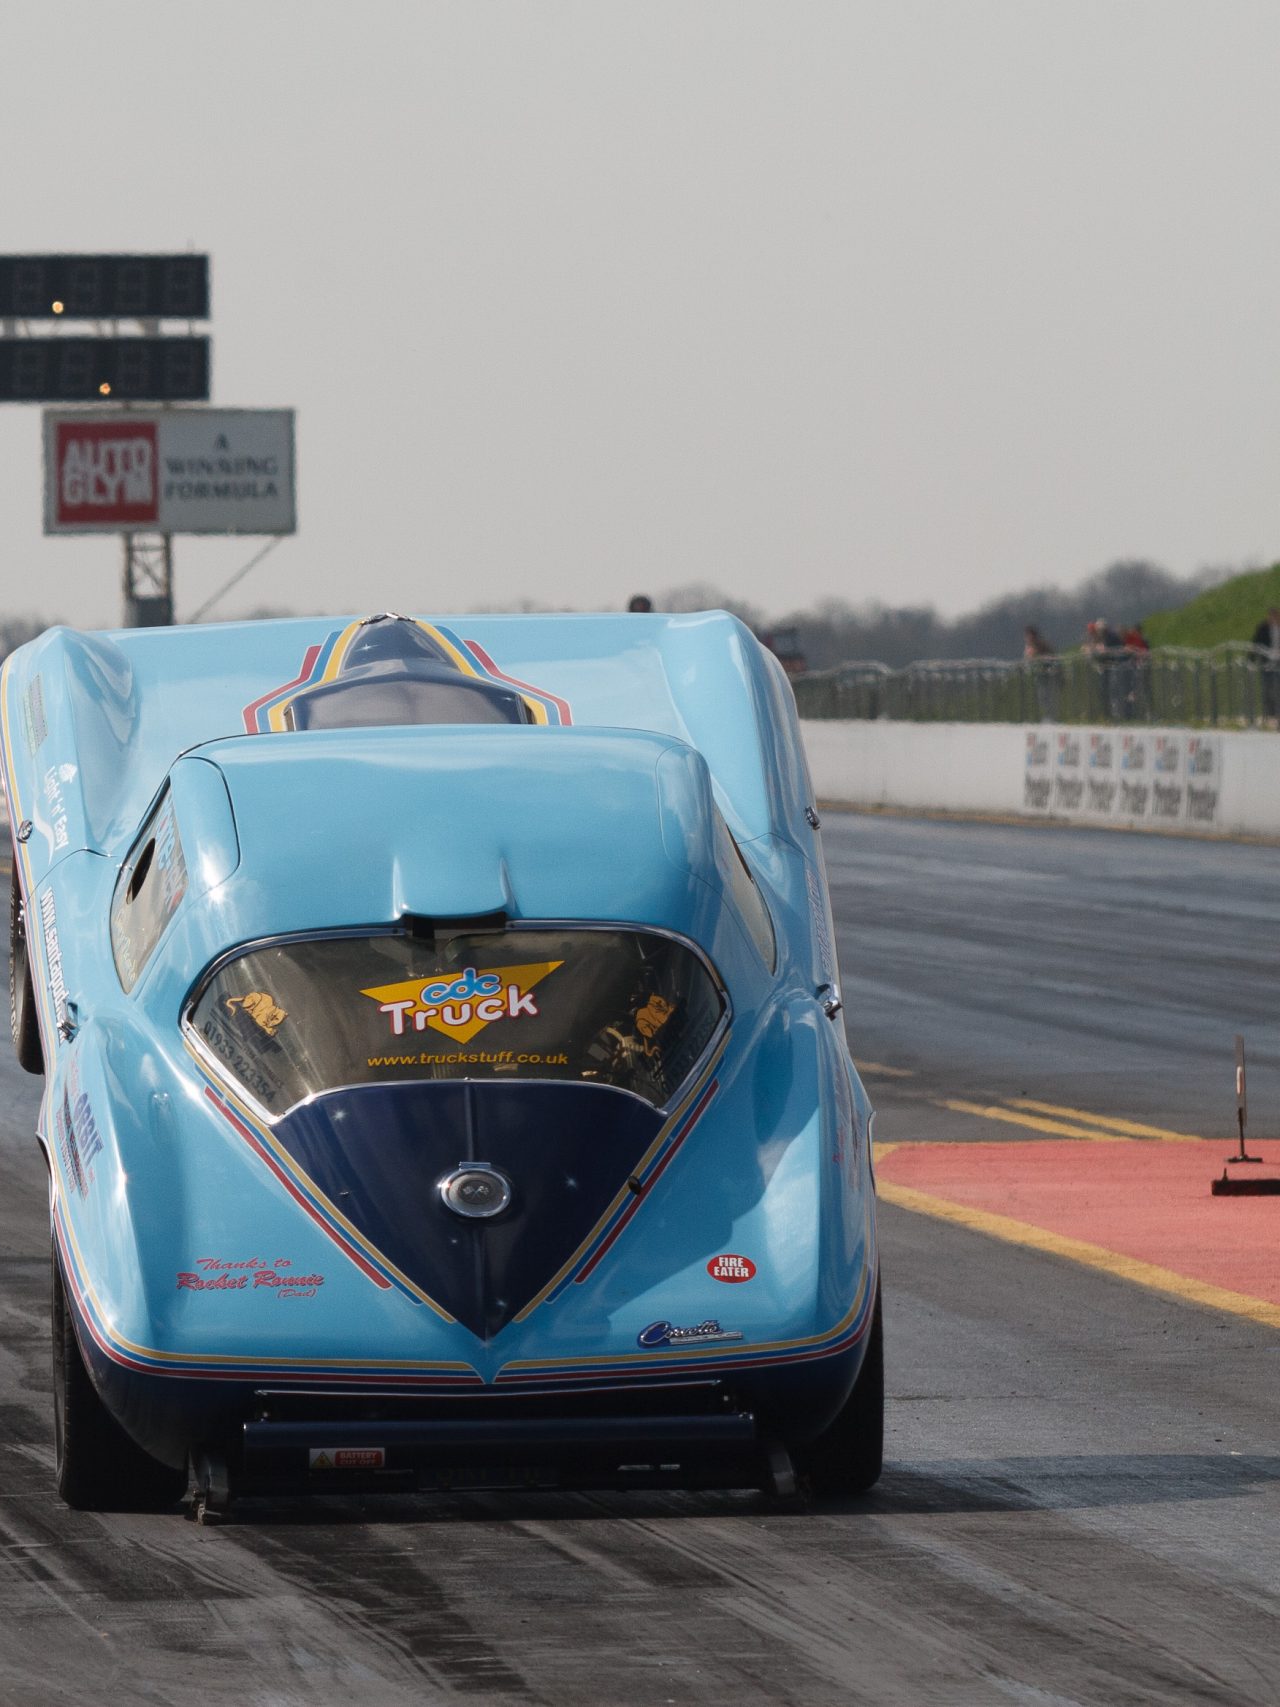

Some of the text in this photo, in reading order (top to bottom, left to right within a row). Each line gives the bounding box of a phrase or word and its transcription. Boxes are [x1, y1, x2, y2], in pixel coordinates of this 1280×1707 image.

[63, 439, 152, 475] AUTO
[64, 473, 153, 506] GLYM
[166, 480, 278, 499] FORMULA
[44, 765, 60, 804] Light
[54, 815, 69, 850] Easy
[41, 886, 69, 1047] www.santapod.
[378, 984, 538, 1036] Truck
[367, 1051, 569, 1067] www.truckstuff.co.uk
[196, 1257, 292, 1271] Thanks to
[714, 1266, 749, 1277] EATER
[718, 1256, 744, 1268] FIRE
[176, 1270, 325, 1291] Rocket Ronnie
